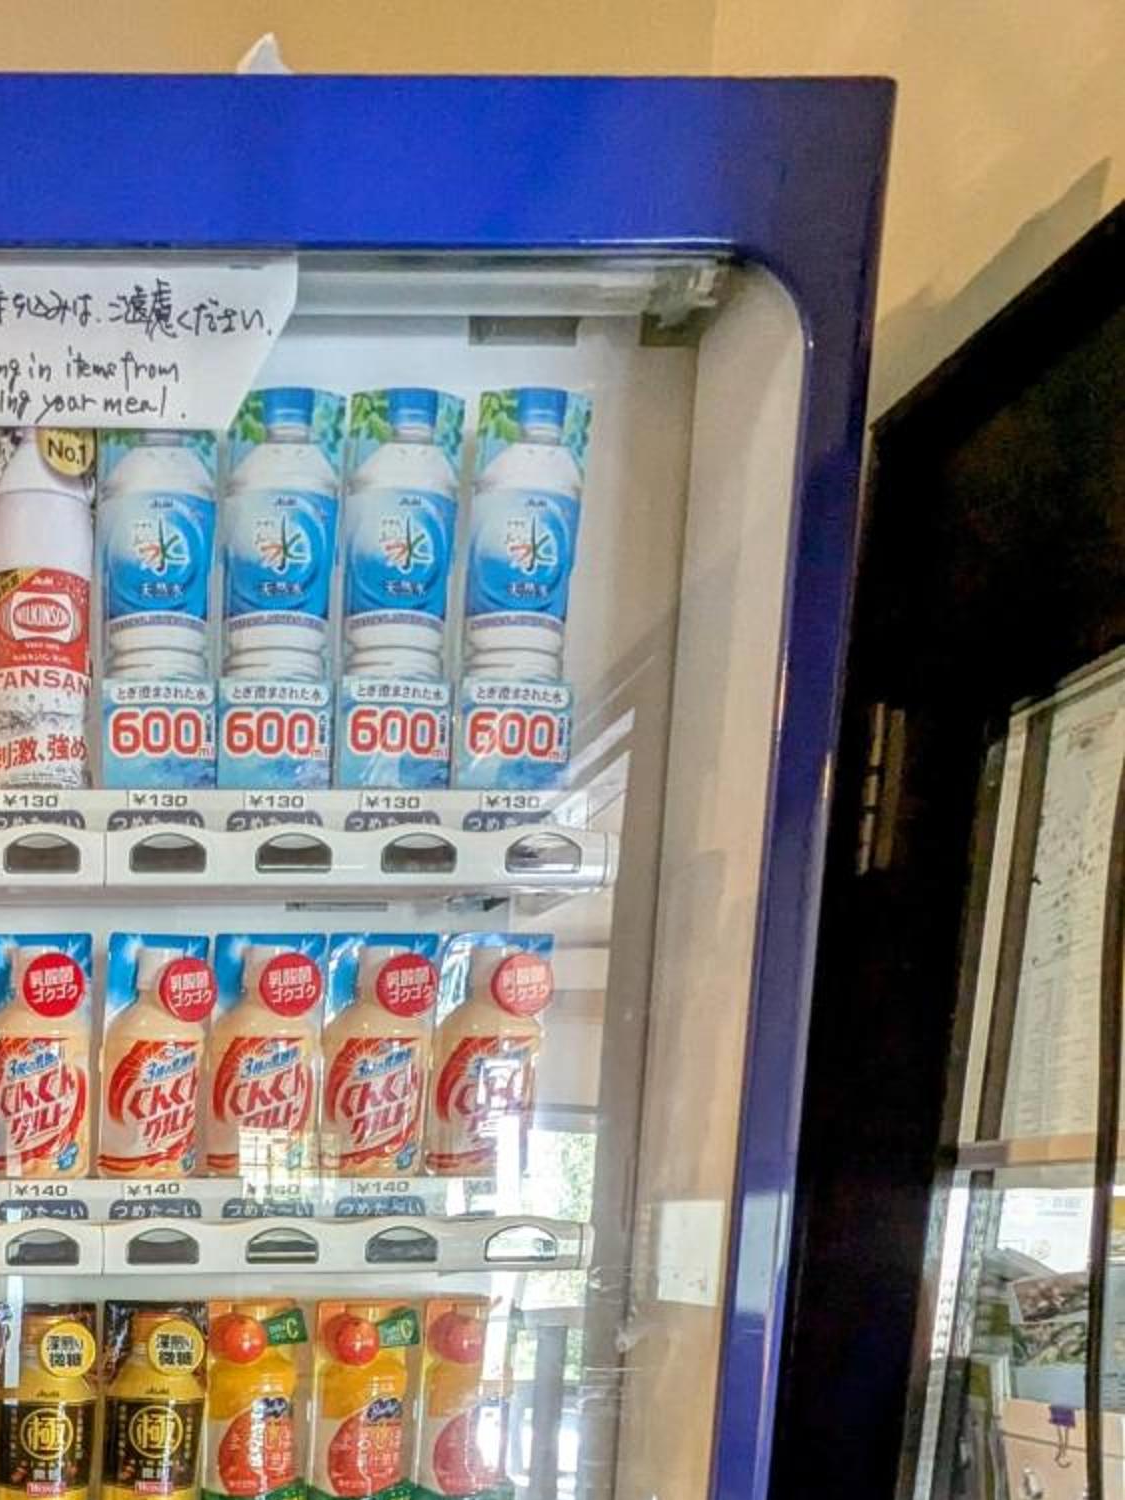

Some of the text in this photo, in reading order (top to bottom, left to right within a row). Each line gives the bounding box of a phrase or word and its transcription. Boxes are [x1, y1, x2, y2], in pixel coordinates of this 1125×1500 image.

[29, 352, 52, 379] in
[65, 345, 117, 378] items
[121, 352, 181, 392] from
[35, 397, 97, 424] your
[46, 438, 89, 464] No.1
[111, 710, 202, 756] 600
[225, 710, 316, 756] 600
[350, 709, 437, 755] 600
[469, 711, 555, 757] 600
[34, 984, 78, 1004] ゴクゴク
[271, 982, 315, 1003] ゴクゴク
[390, 982, 433, 1004] ゴクゴク
[14, 1184, 68, 1196] ¥140
[127, 1183, 180, 1195] ¥140
